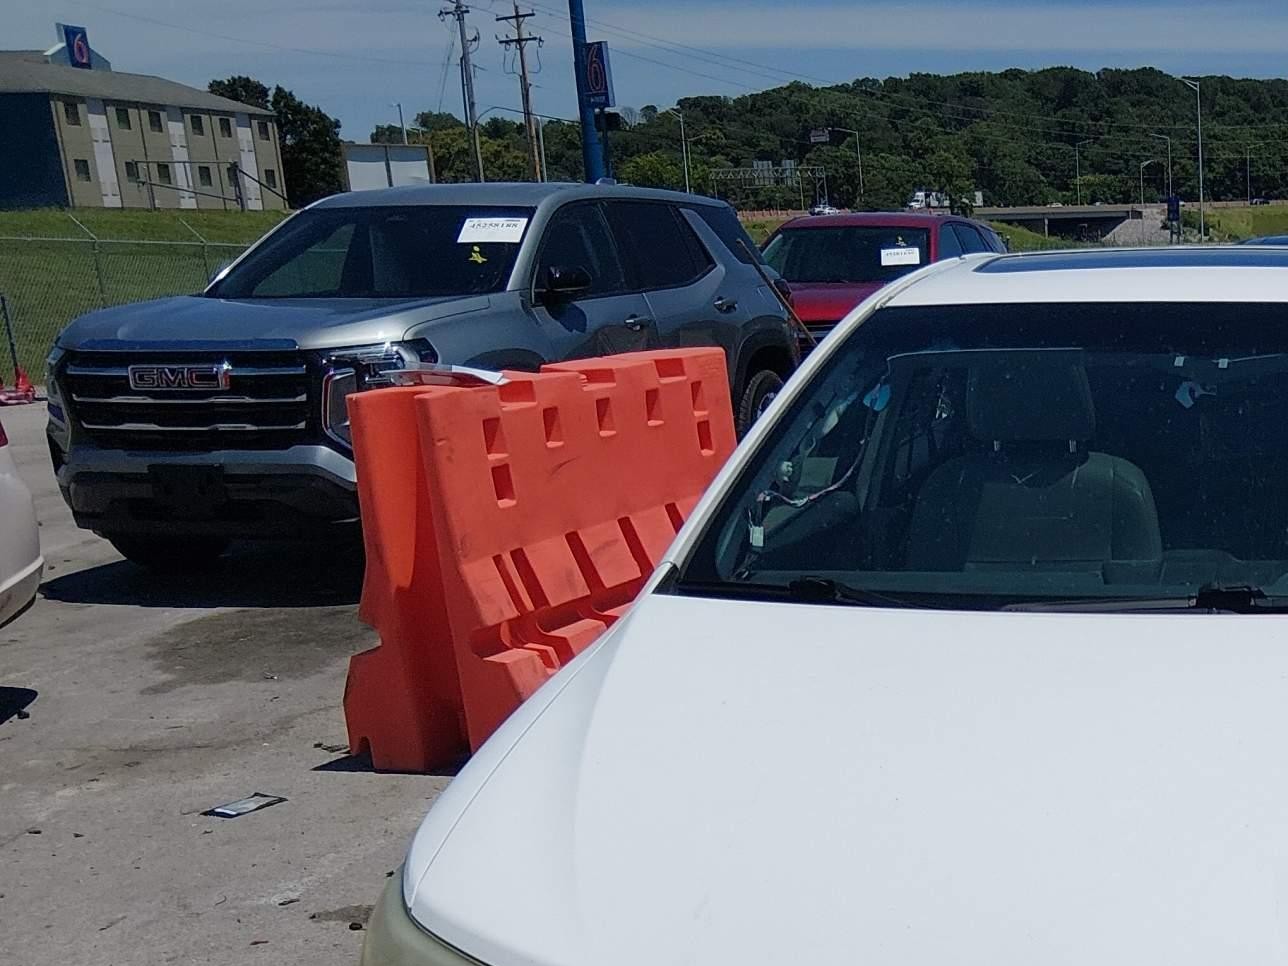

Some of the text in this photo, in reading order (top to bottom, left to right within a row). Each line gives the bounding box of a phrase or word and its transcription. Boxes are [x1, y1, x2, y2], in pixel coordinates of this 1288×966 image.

[73, 32, 88, 63] 6
[587, 45, 605, 91] 6
[130, 367, 218, 387] GMC
